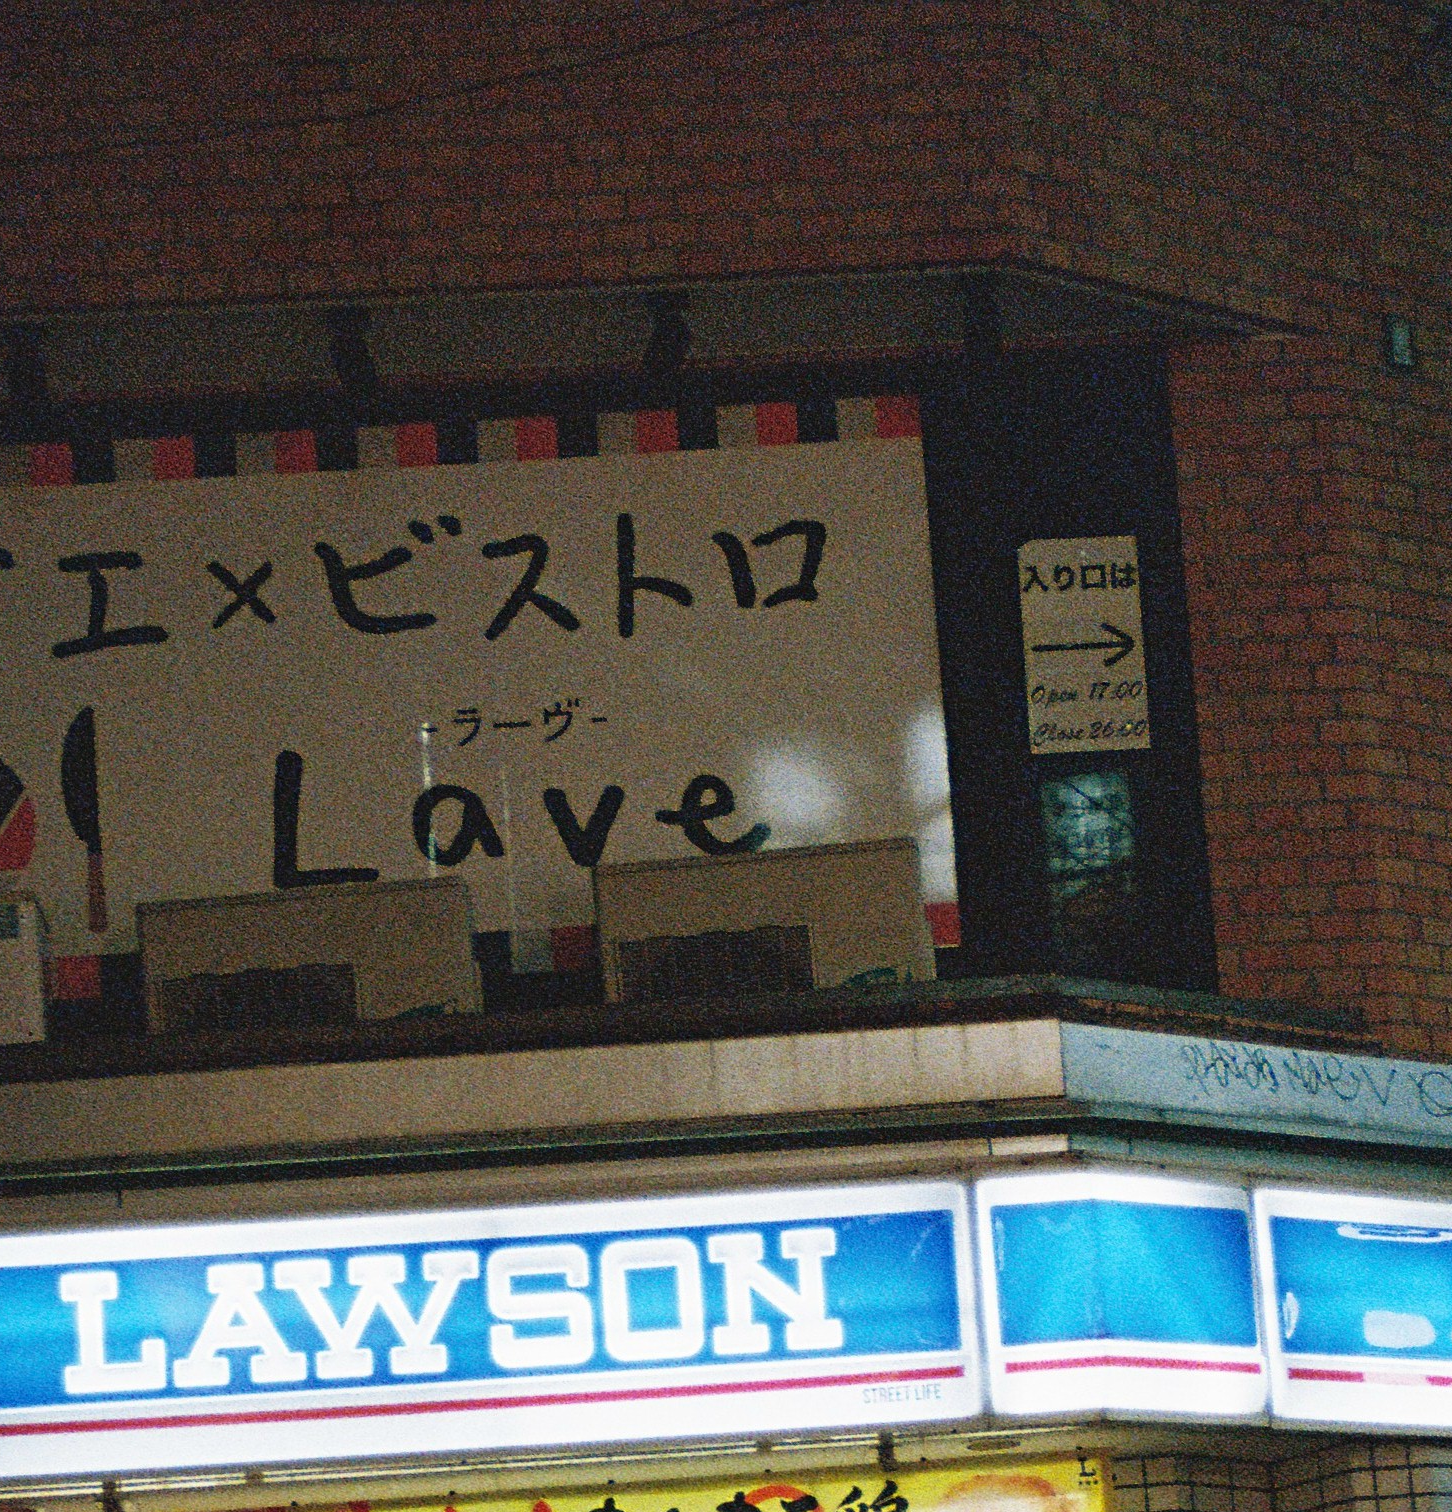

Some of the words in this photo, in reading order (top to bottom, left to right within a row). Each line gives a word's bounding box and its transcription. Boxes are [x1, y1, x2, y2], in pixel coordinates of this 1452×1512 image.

[1023, 563, 1138, 592] 入り口は
[1031, 682, 1079, 706] Open
[1088, 679, 1143, 703] 17:00
[273, 750, 771, 888] Lave
[58, 1226, 845, 1398] LAWSON
[862, 1386, 911, 1405] STREET
[915, 1383, 943, 1401] LIFE
